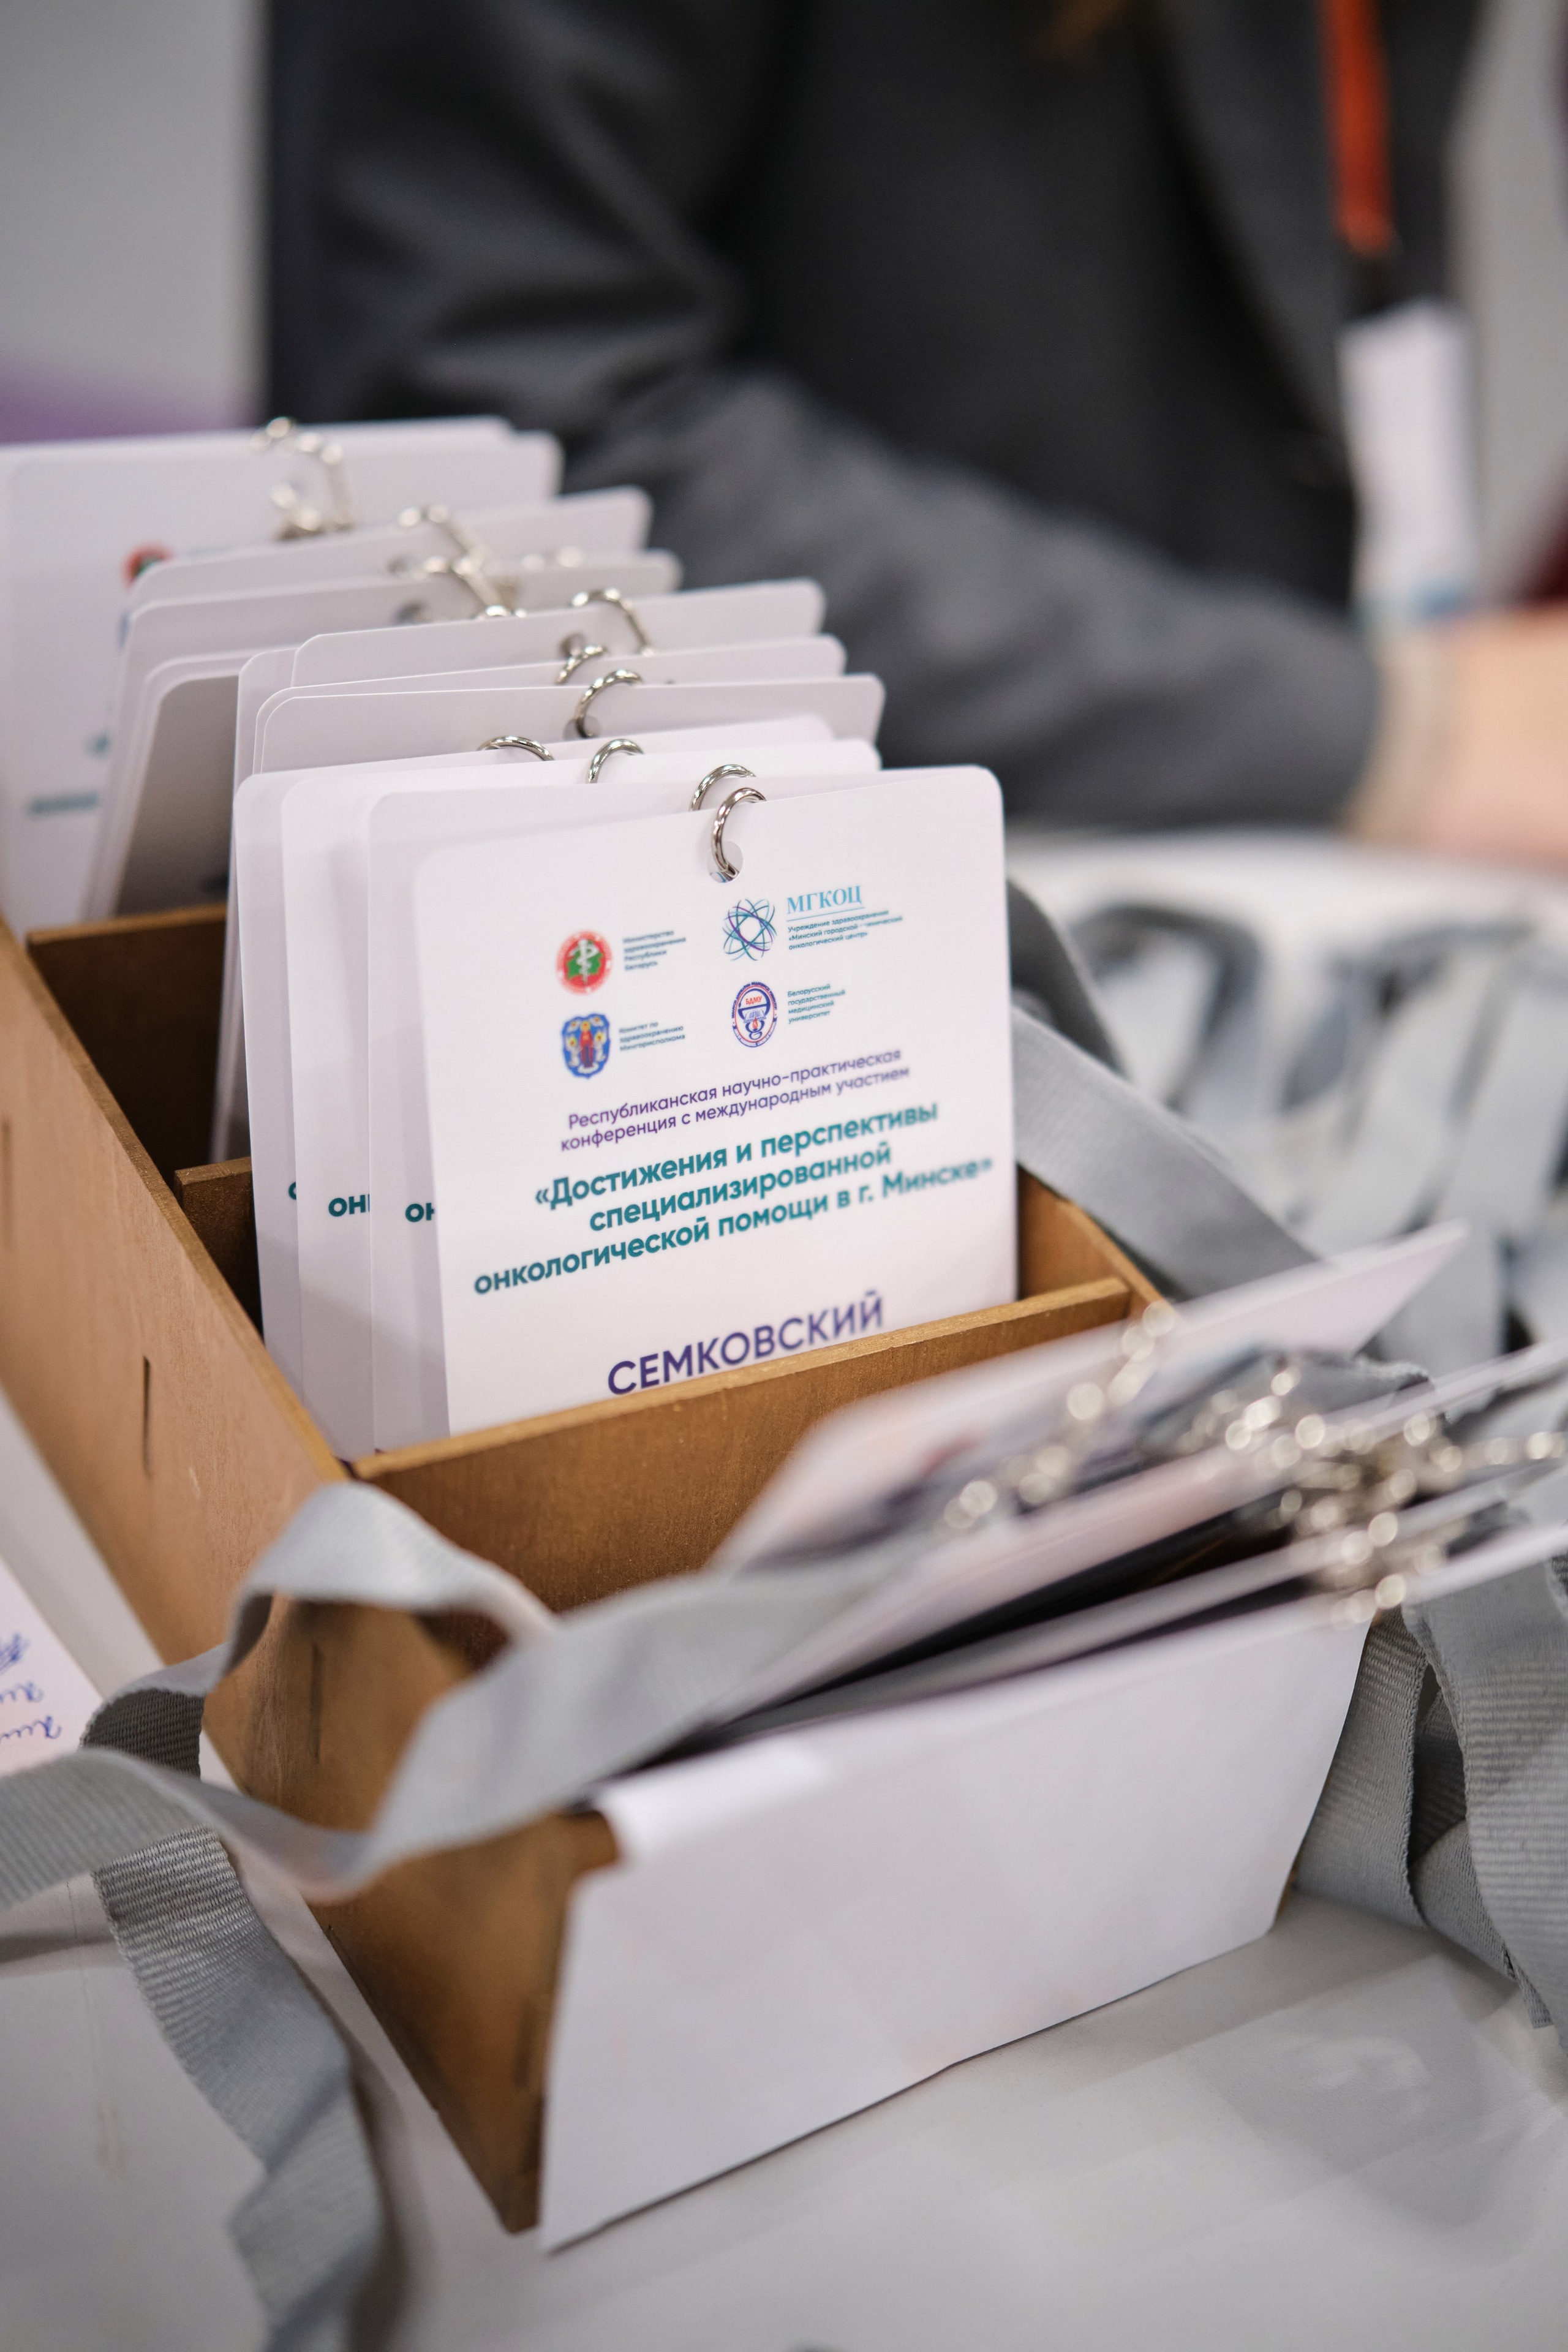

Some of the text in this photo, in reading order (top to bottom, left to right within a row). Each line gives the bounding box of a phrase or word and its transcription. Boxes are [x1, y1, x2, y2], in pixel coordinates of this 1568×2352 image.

[786, 885, 862, 914] МГКОЦ
[788, 921, 830, 932] Учреждение
[788, 930, 822, 941] «Минский
[824, 924, 858, 935] городской
[788, 935, 843, 951] онкологический
[788, 984, 831, 997] Белорусский
[788, 989, 845, 1006] государственный
[745, 996, 762, 1005] БДМУ
[788, 1000, 834, 1014] медицинский
[788, 1011, 831, 1025] университет
[568, 1049, 902, 1129] Республиканская научно-практическая
[561, 1068, 910, 1152] конференция с международным участием
[535, 1102, 938, 1210] «Достижения и перспективы
[589, 1141, 891, 1232] специализированной
[474, 1158, 993, 1294] онкологической помощи в г. Минске»
[608, 1290, 884, 1396] СЕМКОВСКИЙ
